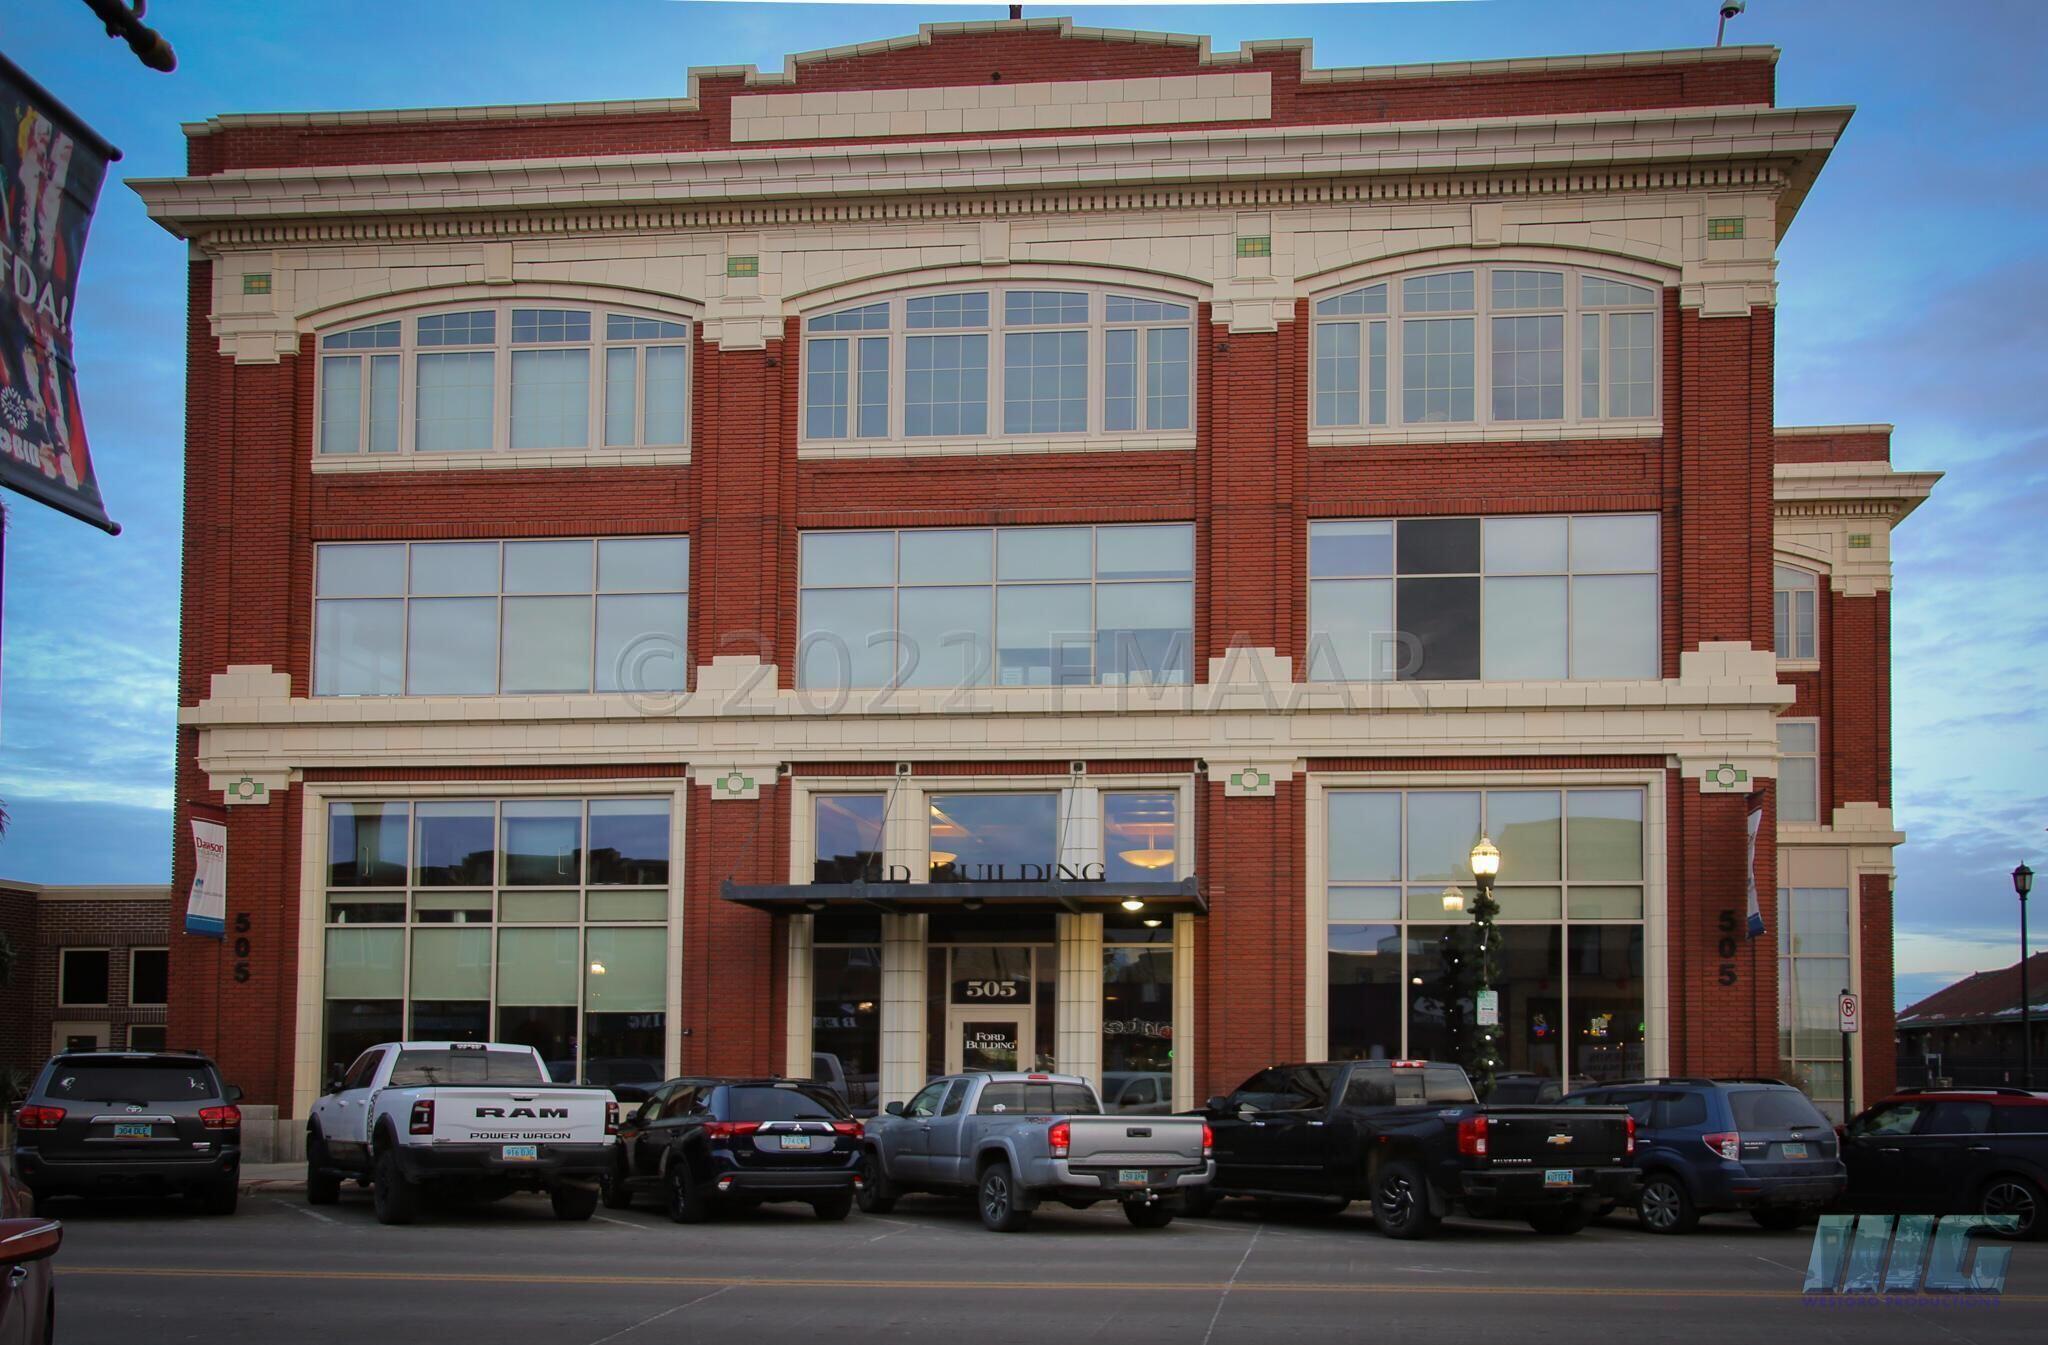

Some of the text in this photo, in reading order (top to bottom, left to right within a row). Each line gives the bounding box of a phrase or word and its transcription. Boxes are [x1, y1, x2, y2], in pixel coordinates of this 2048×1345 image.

[235, 912, 251, 983] 505
[1717, 909, 1738, 986] 505
[966, 980, 1017, 997] 505
[966, 1040, 1015, 1050] BUILDING
[476, 1107, 569, 1119] RAM
[470, 1132, 571, 1140] POWER WAGON
